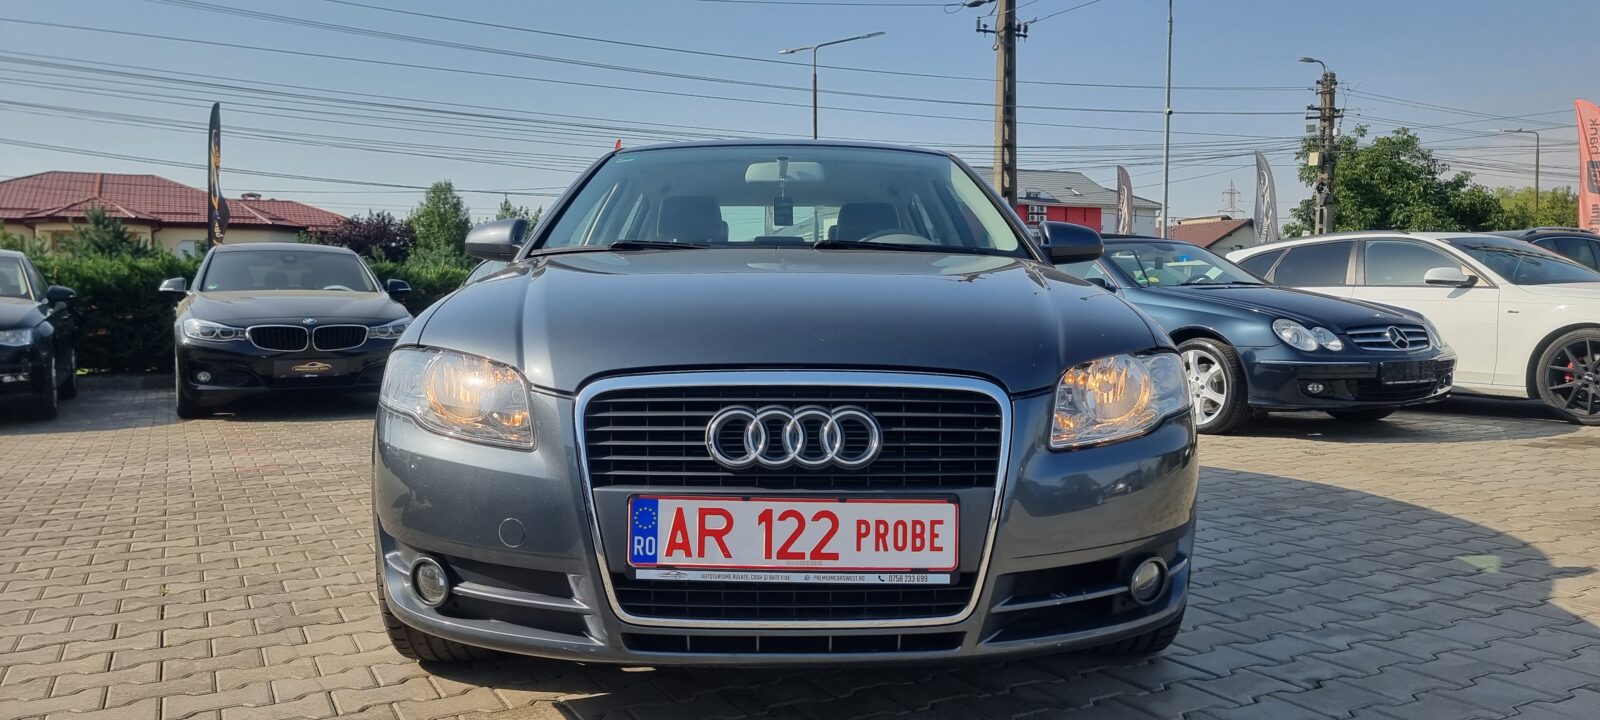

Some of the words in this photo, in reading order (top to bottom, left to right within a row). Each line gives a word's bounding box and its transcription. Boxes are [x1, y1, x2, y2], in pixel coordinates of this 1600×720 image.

[664, 507, 734, 559] AR
[757, 508, 840, 561] 122
[856, 519, 944, 552] PROBE
[634, 536, 656, 556] RO
[904, 574, 916, 583] 233
